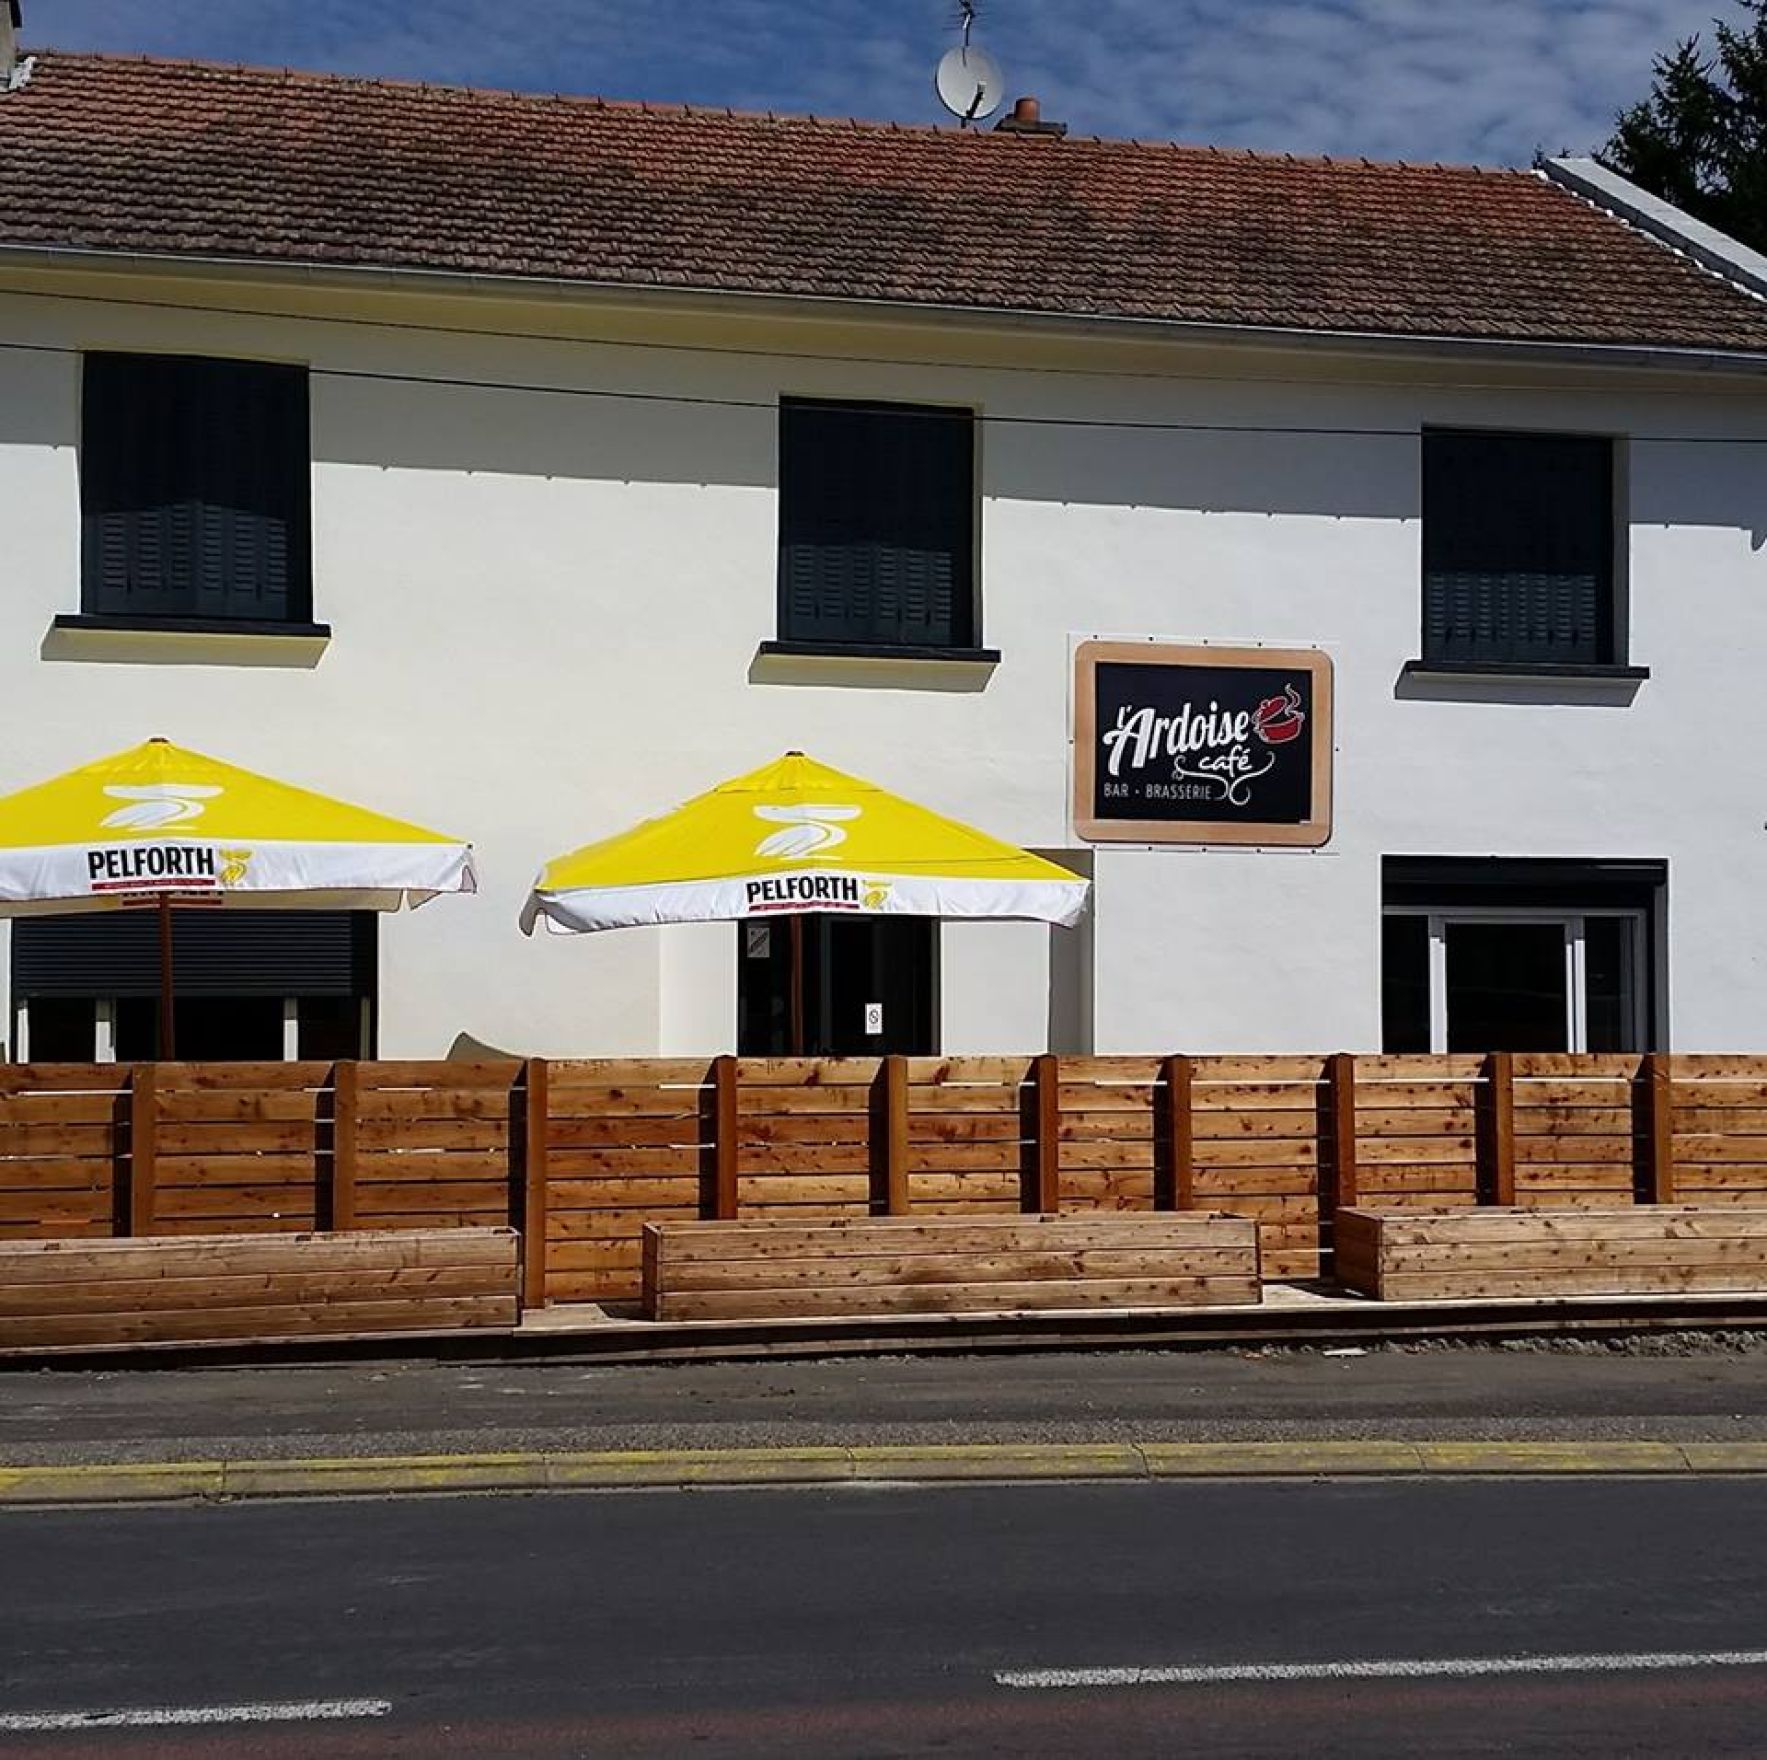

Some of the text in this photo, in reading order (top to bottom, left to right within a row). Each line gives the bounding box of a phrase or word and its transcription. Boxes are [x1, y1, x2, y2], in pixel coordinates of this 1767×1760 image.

[1198, 744, 1253, 777] café
[1103, 783, 1212, 800] BAR BRASSERIE
[88, 846, 214, 879] PELFORTH
[747, 875, 858, 903] PELFORTH
